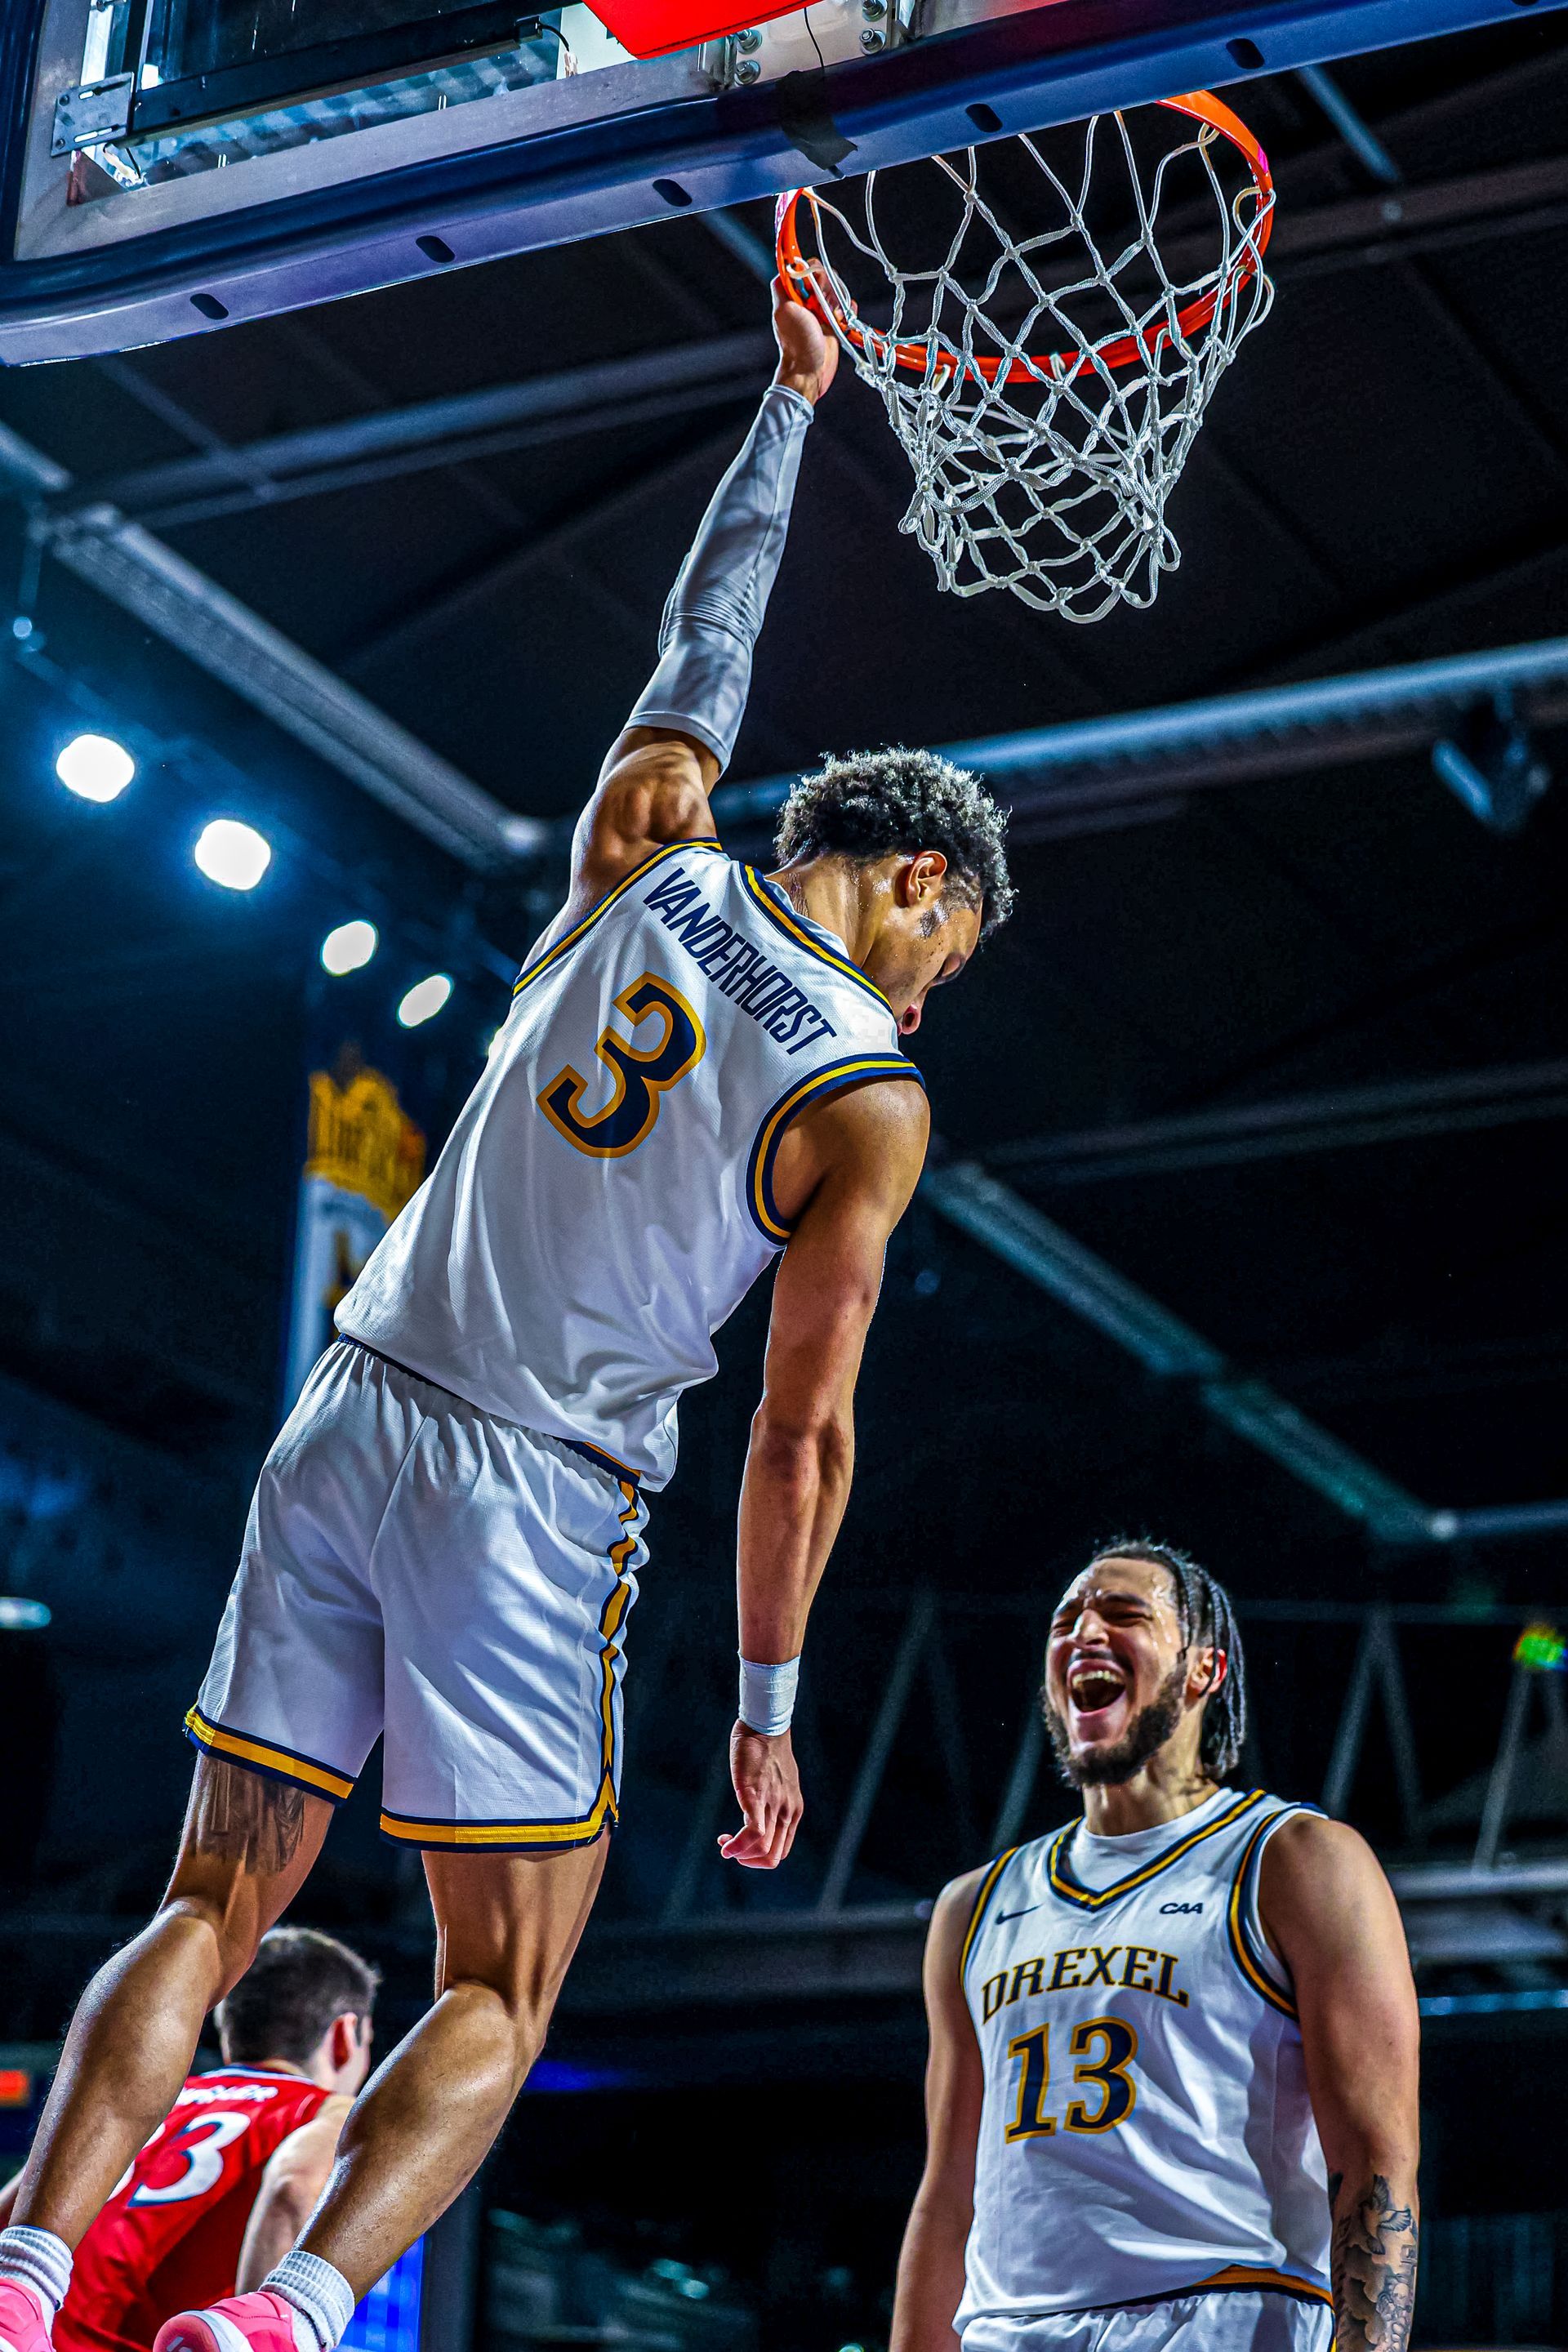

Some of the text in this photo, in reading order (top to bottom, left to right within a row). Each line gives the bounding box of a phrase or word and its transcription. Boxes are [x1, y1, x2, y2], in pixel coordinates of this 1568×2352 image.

[643, 866, 837, 1055] VANDERHORST
[537, 971, 706, 1159] 3
[1159, 1902, 1204, 1914] CAA
[982, 1946, 1189, 2025] DREXEL
[1005, 2016, 1138, 2144] 13
[106, 2109, 252, 2207] 3
